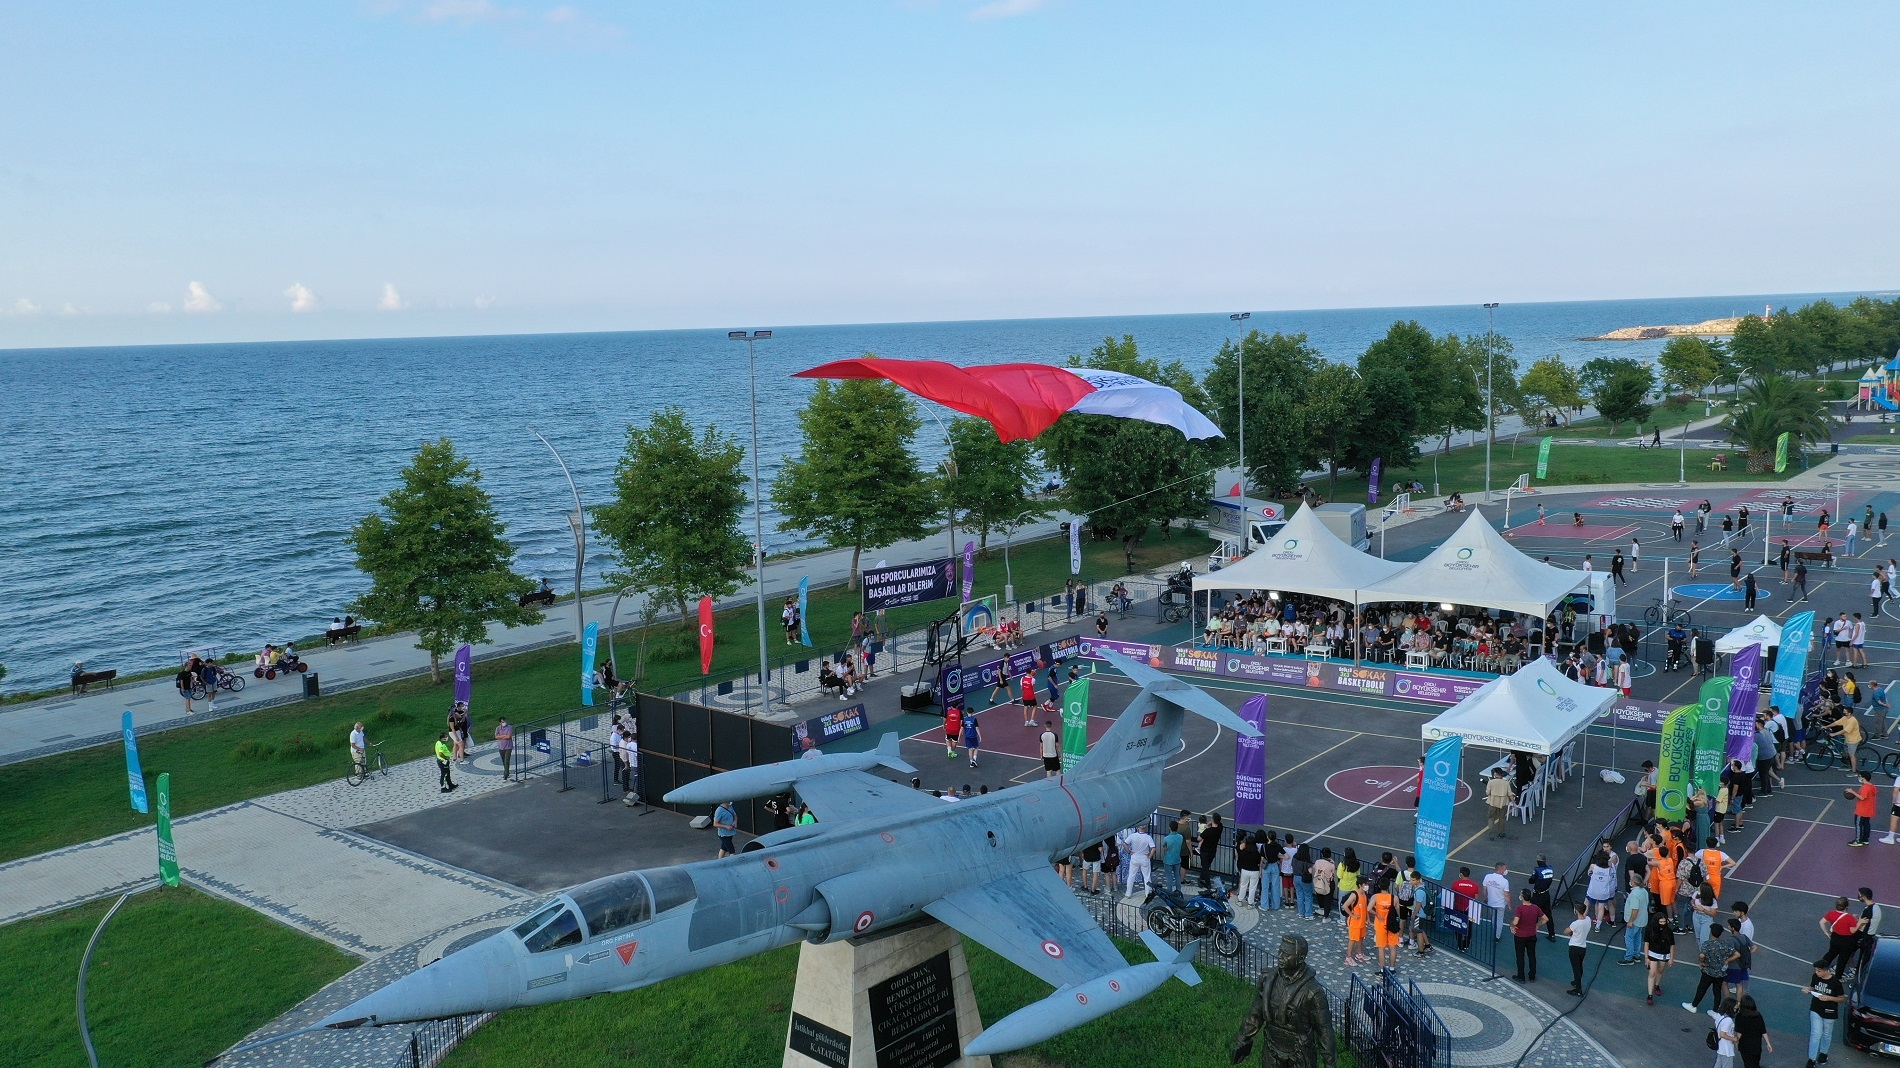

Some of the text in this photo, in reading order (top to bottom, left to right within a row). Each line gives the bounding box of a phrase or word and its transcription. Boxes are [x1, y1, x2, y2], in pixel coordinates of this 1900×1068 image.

[865, 565, 936, 585] TÜM SPORCULARIMIZA
[868, 584, 906, 599] BAŞARILAR
[1175, 657, 1217, 668] BASKETBOLU
[1338, 677, 1384, 689] BASKETBOLU
[1412, 684, 1447, 694] BÜYÜKŞEHİR
[1774, 688, 1797, 696] ORDU
[824, 716, 860, 736] BASKETBOLU
[1728, 729, 1752, 737] ORDU
[1464, 734, 1504, 744] BÜYÜKŞEHİR
[1506, 740, 1542, 750] BELEDİYESİ
[1662, 733, 1672, 758] ORDU
[1669, 715, 1687, 782] BÜYÜKŞEHİR
[1682, 727, 1694, 772] BELEDİYESİ
[1696, 764, 1718, 772] ORDU
[1236, 774, 1261, 782] DÜŞÜNEN
[1236, 780, 1261, 788] ÜRETEN
[1236, 792, 1262, 800] ORDU
[1418, 825, 1446, 837] ÜRETEN
[1419, 819, 1447, 830] DÜŞÜNEN
[1416, 836, 1445, 850] ORDU
[1418, 831, 1445, 842] YARIŞAN
[890, 966, 930, 990] ORDU'DAN,
[886, 974, 937, 1005] BENDEN DAHA
[889, 984, 937, 1014] YÜKSEKLERE
[878, 987, 949, 1033] ÇIKACAK GENÇLERİ
[891, 1005, 940, 1036] BEKLİYORUM
[922, 1024, 946, 1041] FIRTINA
[810, 1043, 845, 1066] K.ATATÜRK
